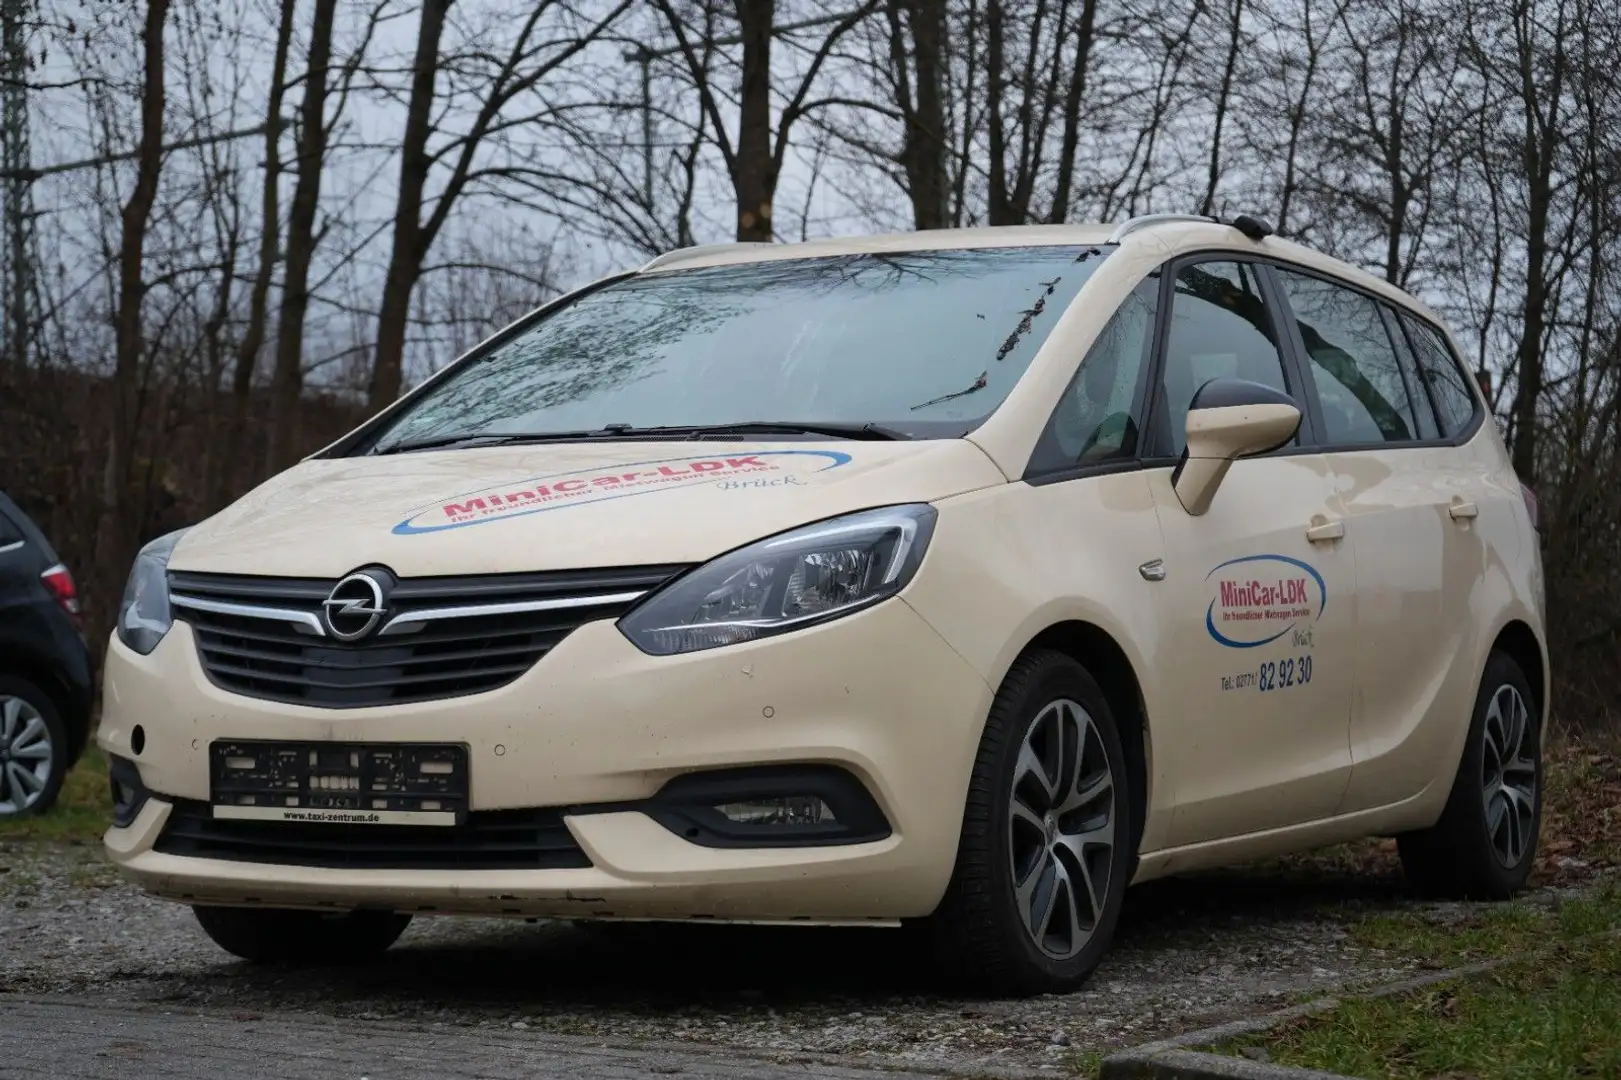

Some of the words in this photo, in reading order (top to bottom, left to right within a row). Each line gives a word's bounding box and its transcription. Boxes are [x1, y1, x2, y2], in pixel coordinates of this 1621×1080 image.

[443, 455, 767, 517] MiniCar-LDK
[451, 513, 474, 523] Ihr
[1220, 579, 1307, 607] MiniCar-LDK
[1260, 662, 1275, 691] 82
[1279, 658, 1294, 688] 92
[1297, 655, 1312, 685] 30
[284, 812, 379, 821] www.taxi-zentrum.de
